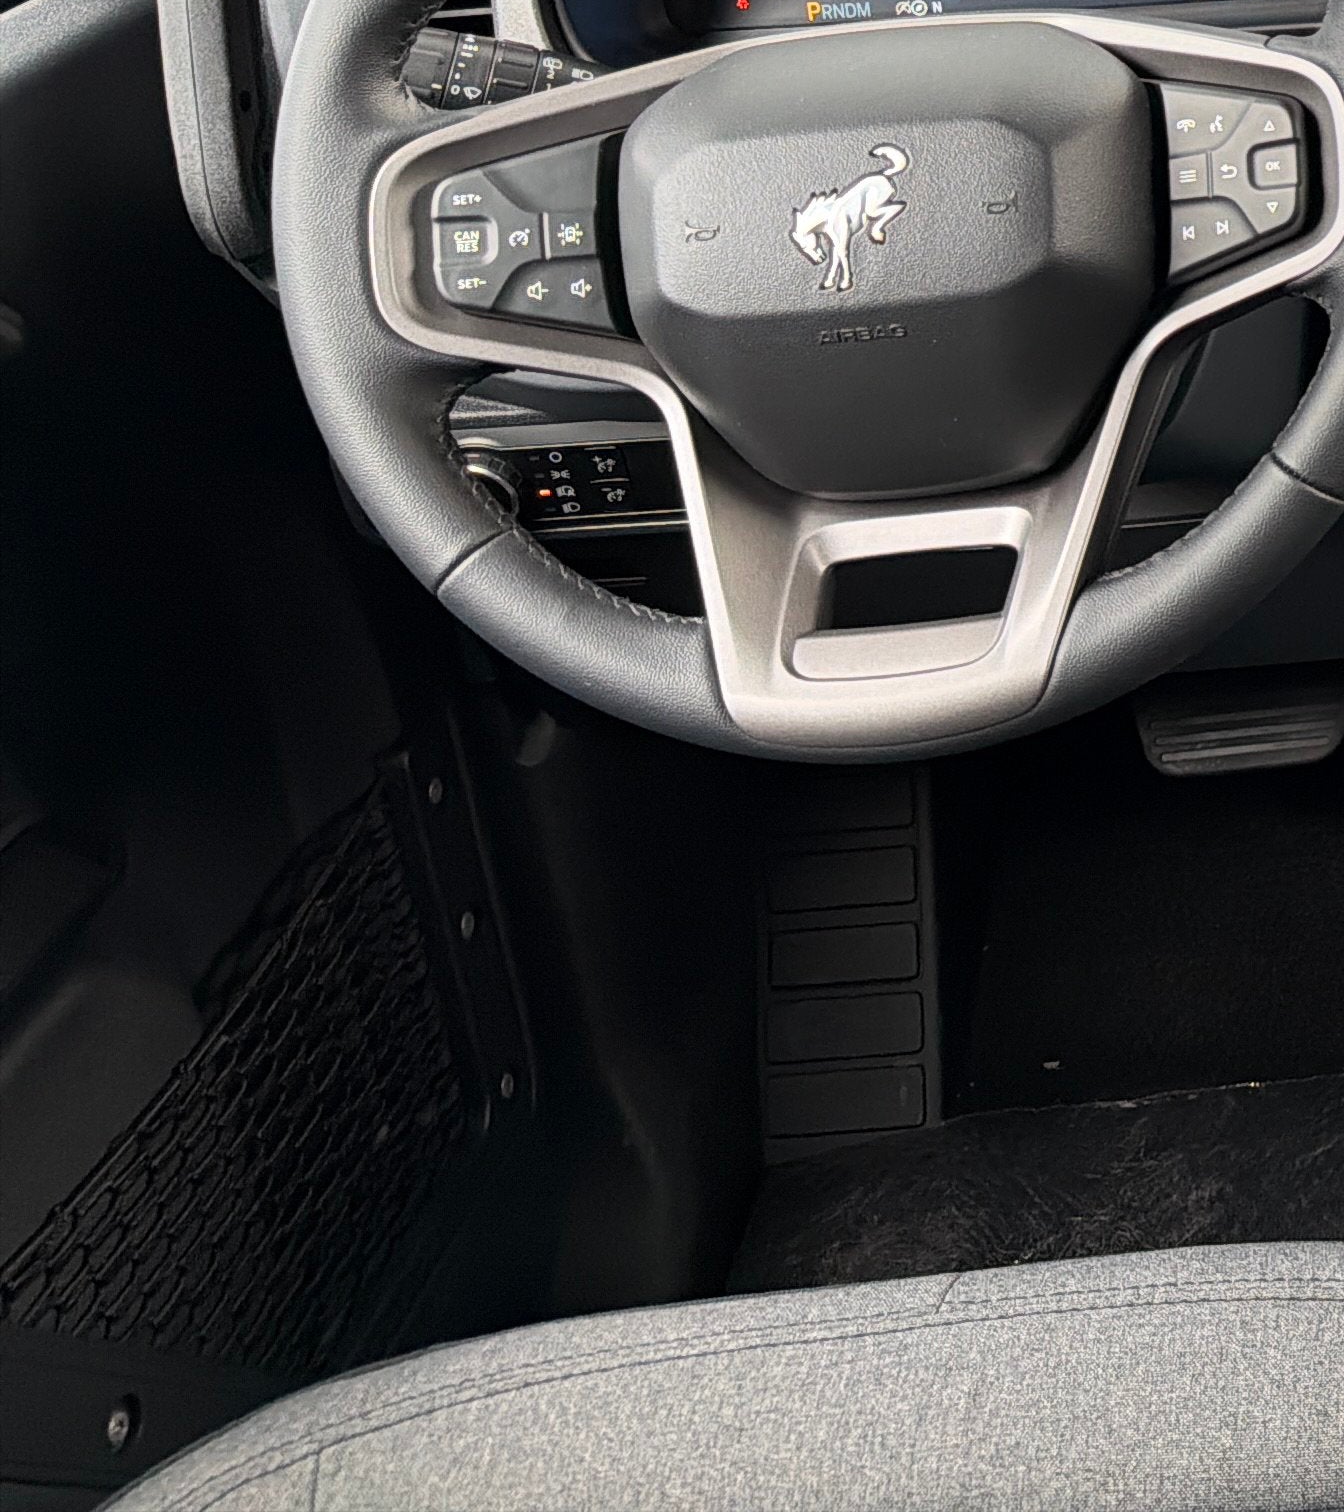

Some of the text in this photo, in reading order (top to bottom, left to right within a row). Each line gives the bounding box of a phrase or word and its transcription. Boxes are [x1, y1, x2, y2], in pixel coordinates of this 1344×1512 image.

[932, 1, 942, 13] N
[1265, 161, 1281, 171] OK
[452, 194, 482, 206] SET+
[454, 231, 480, 242] CAN
[456, 243, 478, 253] RES
[818, 324, 908, 345] AIRBAG
